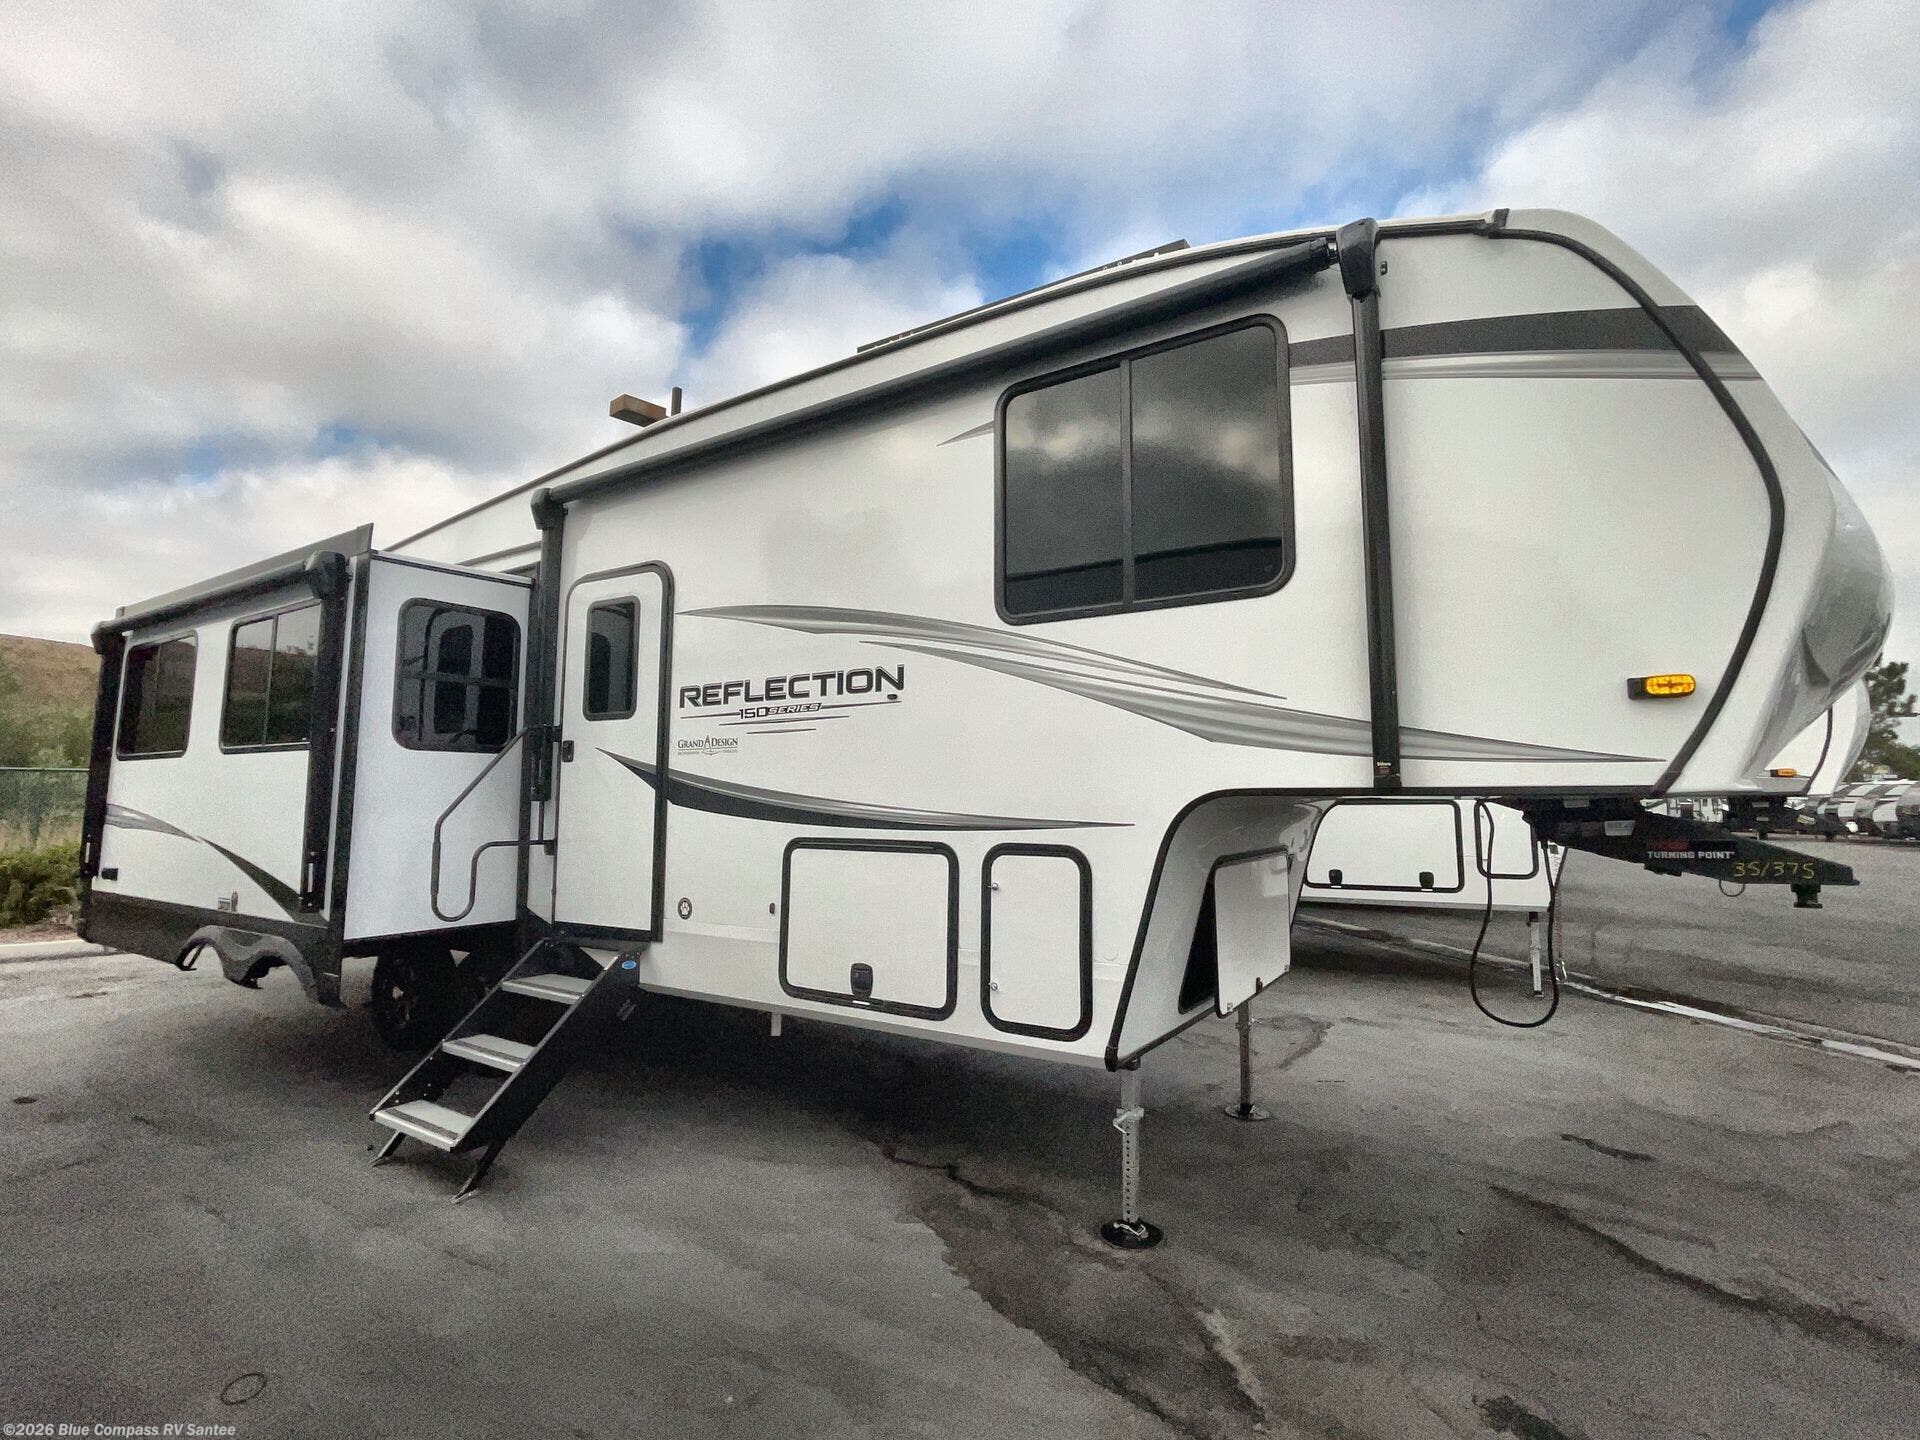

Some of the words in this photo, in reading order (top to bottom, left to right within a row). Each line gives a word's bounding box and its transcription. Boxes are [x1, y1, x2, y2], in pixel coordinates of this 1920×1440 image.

[679, 664, 905, 708] REFLECTION
[739, 706, 768, 719] 150
[767, 703, 820, 715] SERIES
[677, 739, 704, 749] GRAND
[711, 737, 739, 747] DESIGN
[1647, 851, 1695, 859] TURNING
